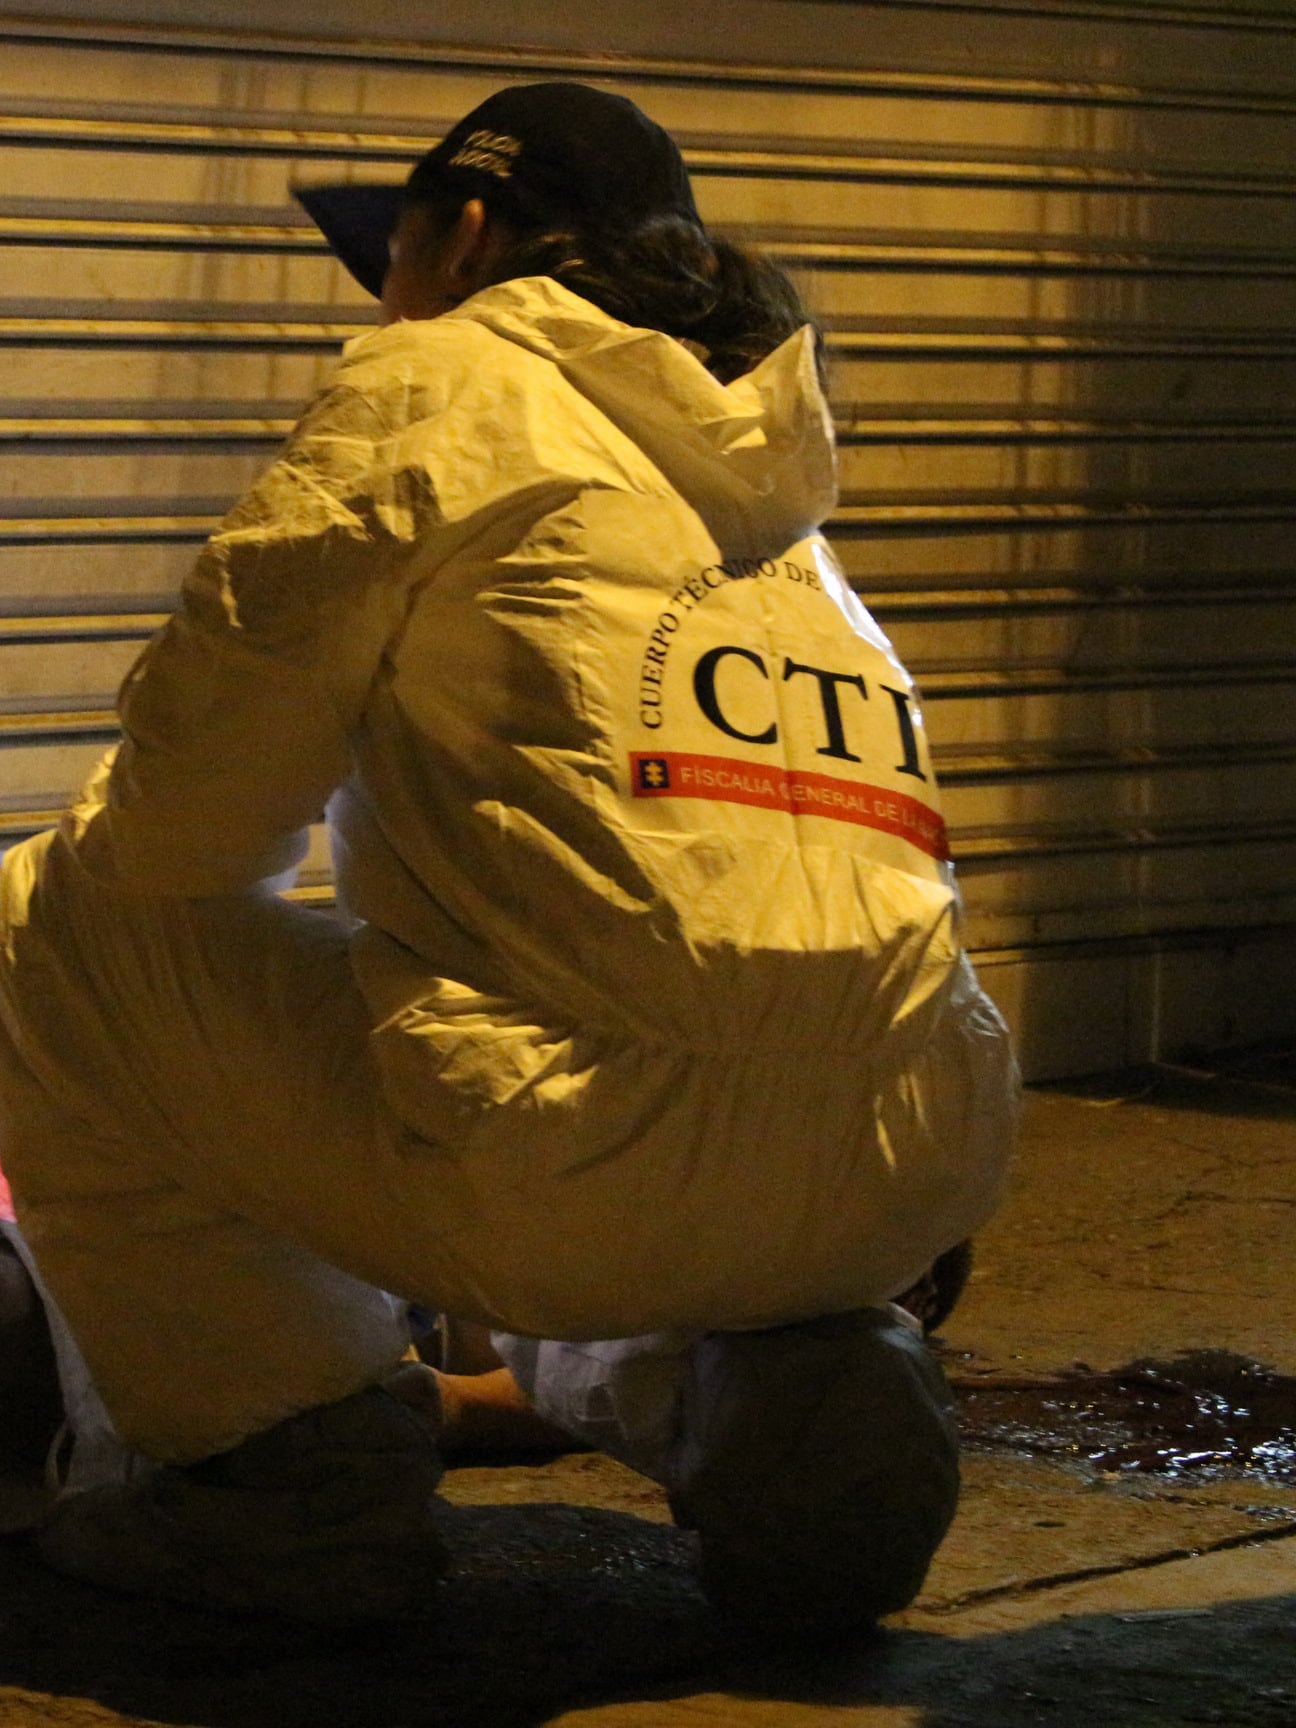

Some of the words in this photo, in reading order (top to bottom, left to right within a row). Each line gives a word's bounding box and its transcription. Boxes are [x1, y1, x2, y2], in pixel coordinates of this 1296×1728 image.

[639, 611, 680, 730] CUERPO
[783, 561, 821, 591] DE
[692, 645, 928, 783] CTI
[873, 799, 901, 822] DE
